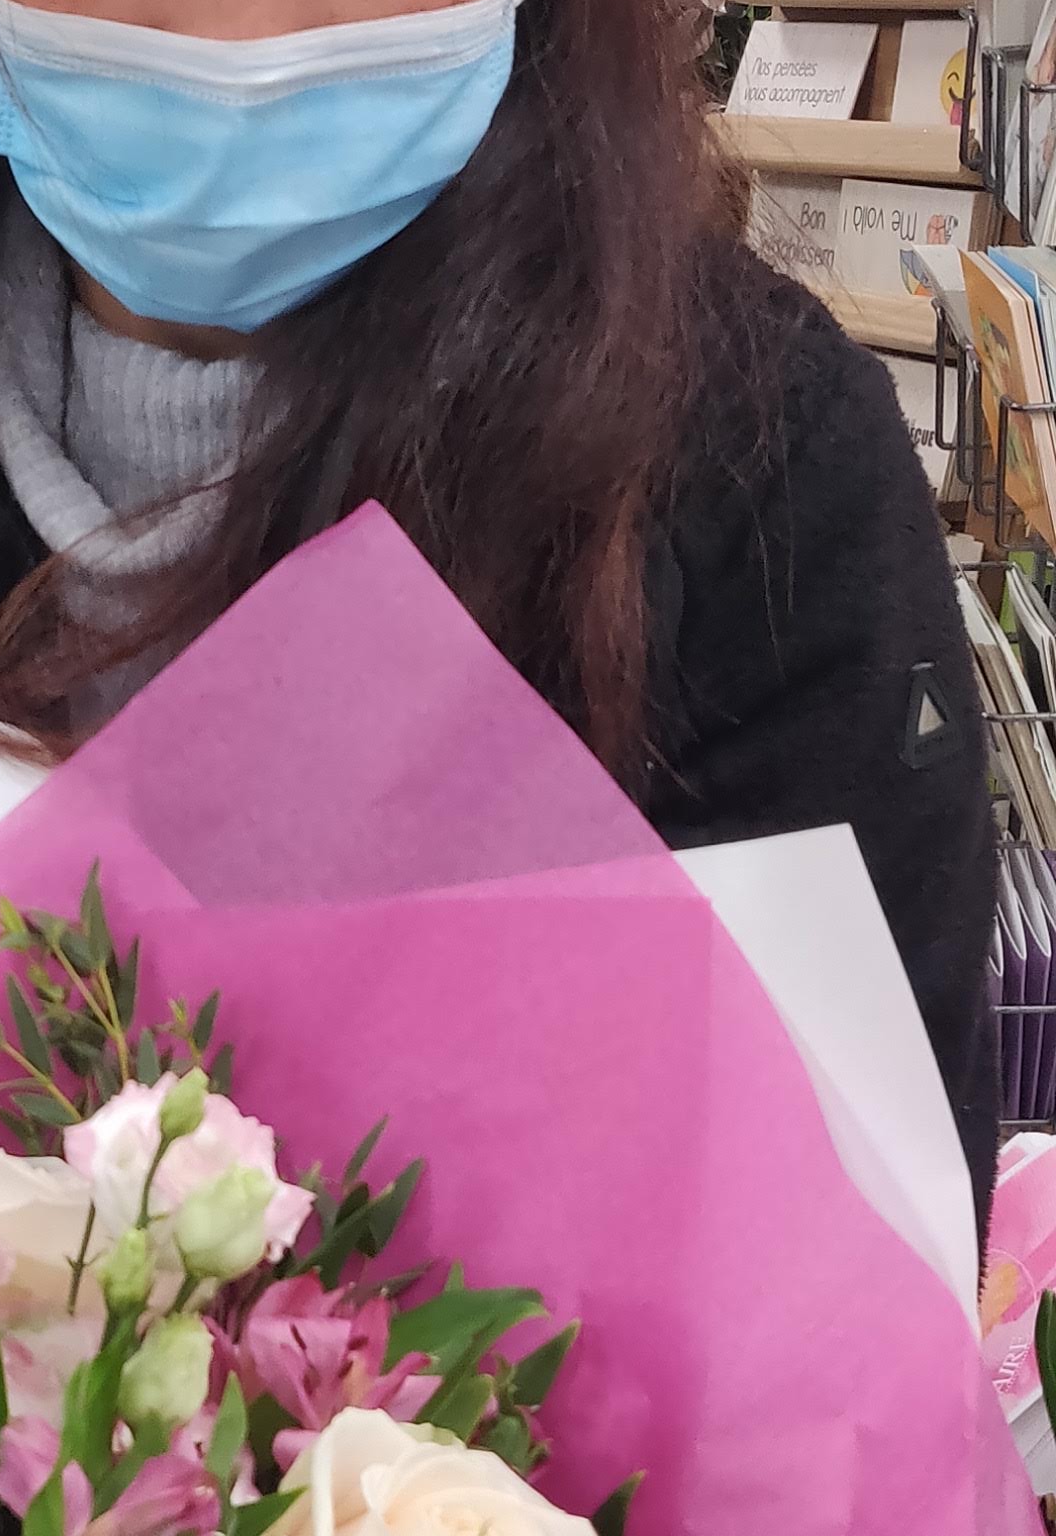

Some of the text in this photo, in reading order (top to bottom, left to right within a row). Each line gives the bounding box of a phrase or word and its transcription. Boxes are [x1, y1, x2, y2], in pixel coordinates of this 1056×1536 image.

[752, 56, 772, 76] Nos
[744, 84, 846, 108] vous accompagnent
[800, 201, 826, 231] Bon
[891, 209, 918, 242] Me
